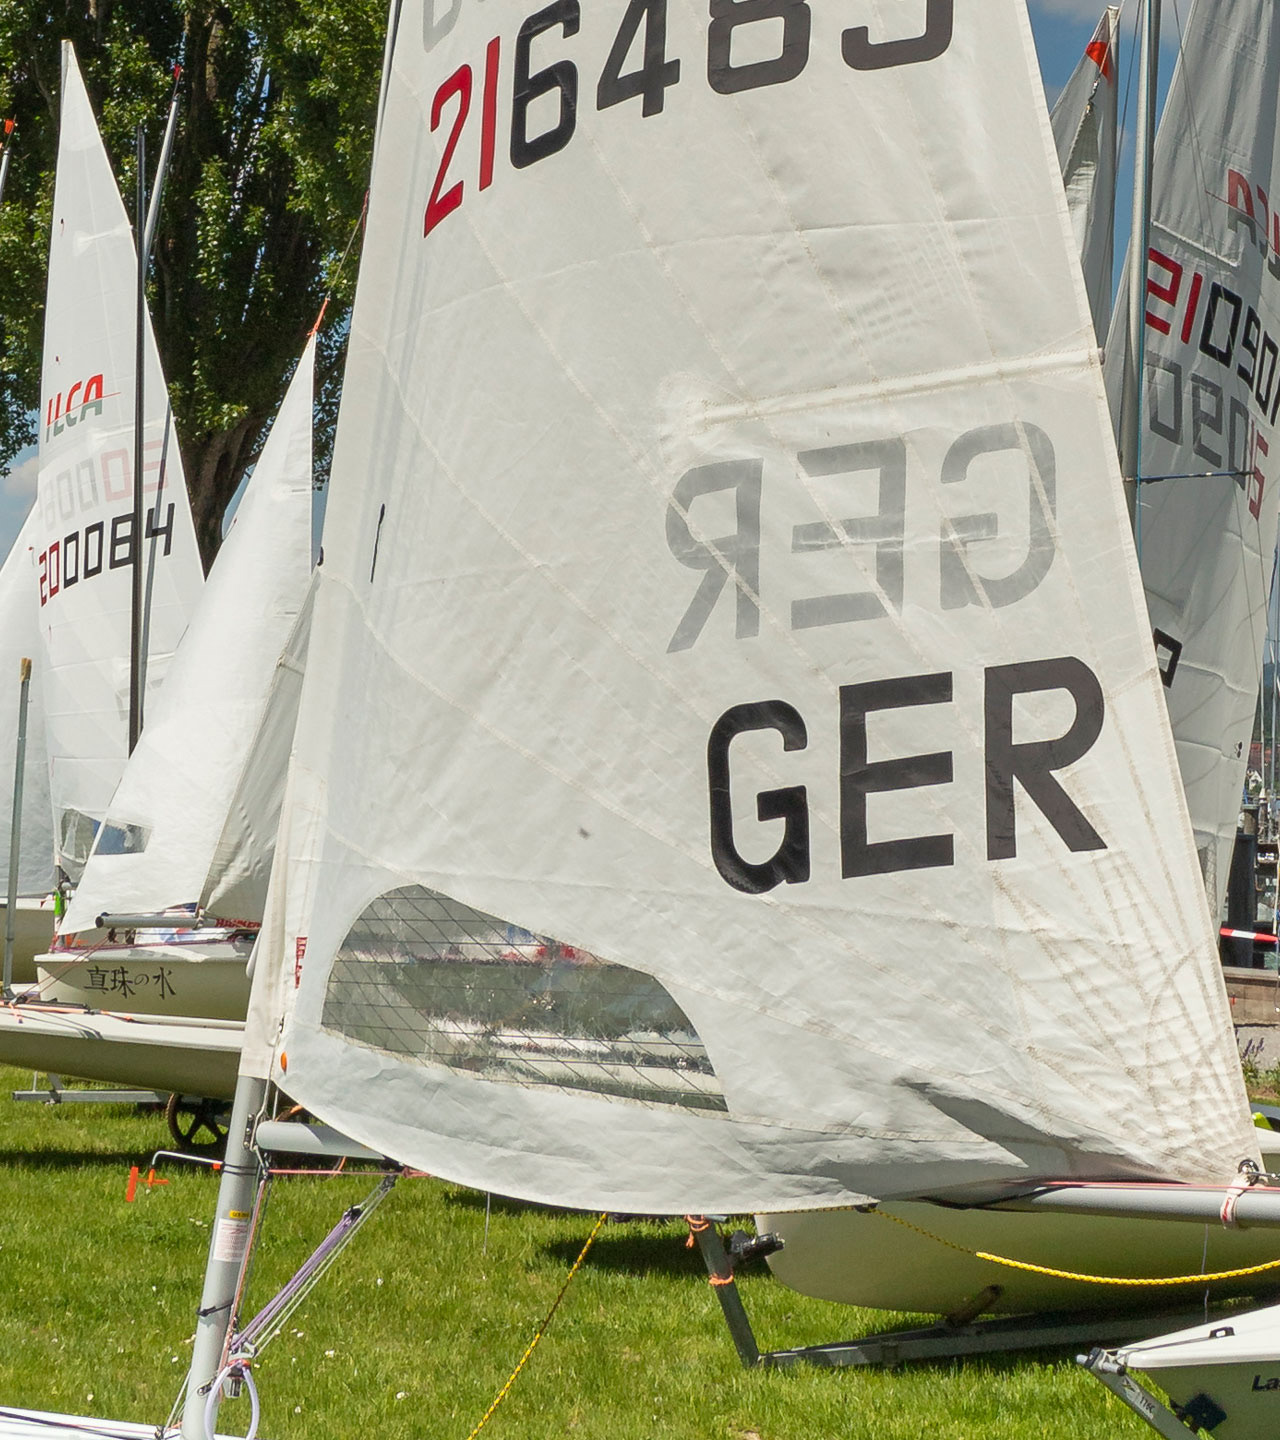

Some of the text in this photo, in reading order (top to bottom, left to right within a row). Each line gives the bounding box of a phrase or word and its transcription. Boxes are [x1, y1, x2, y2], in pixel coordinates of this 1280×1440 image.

[46, 374, 104, 443] ILCA
[39, 502, 176, 607] 200084
[707, 655, 1108, 895] GER
[83, 965, 177, 1001] 真珠の水
